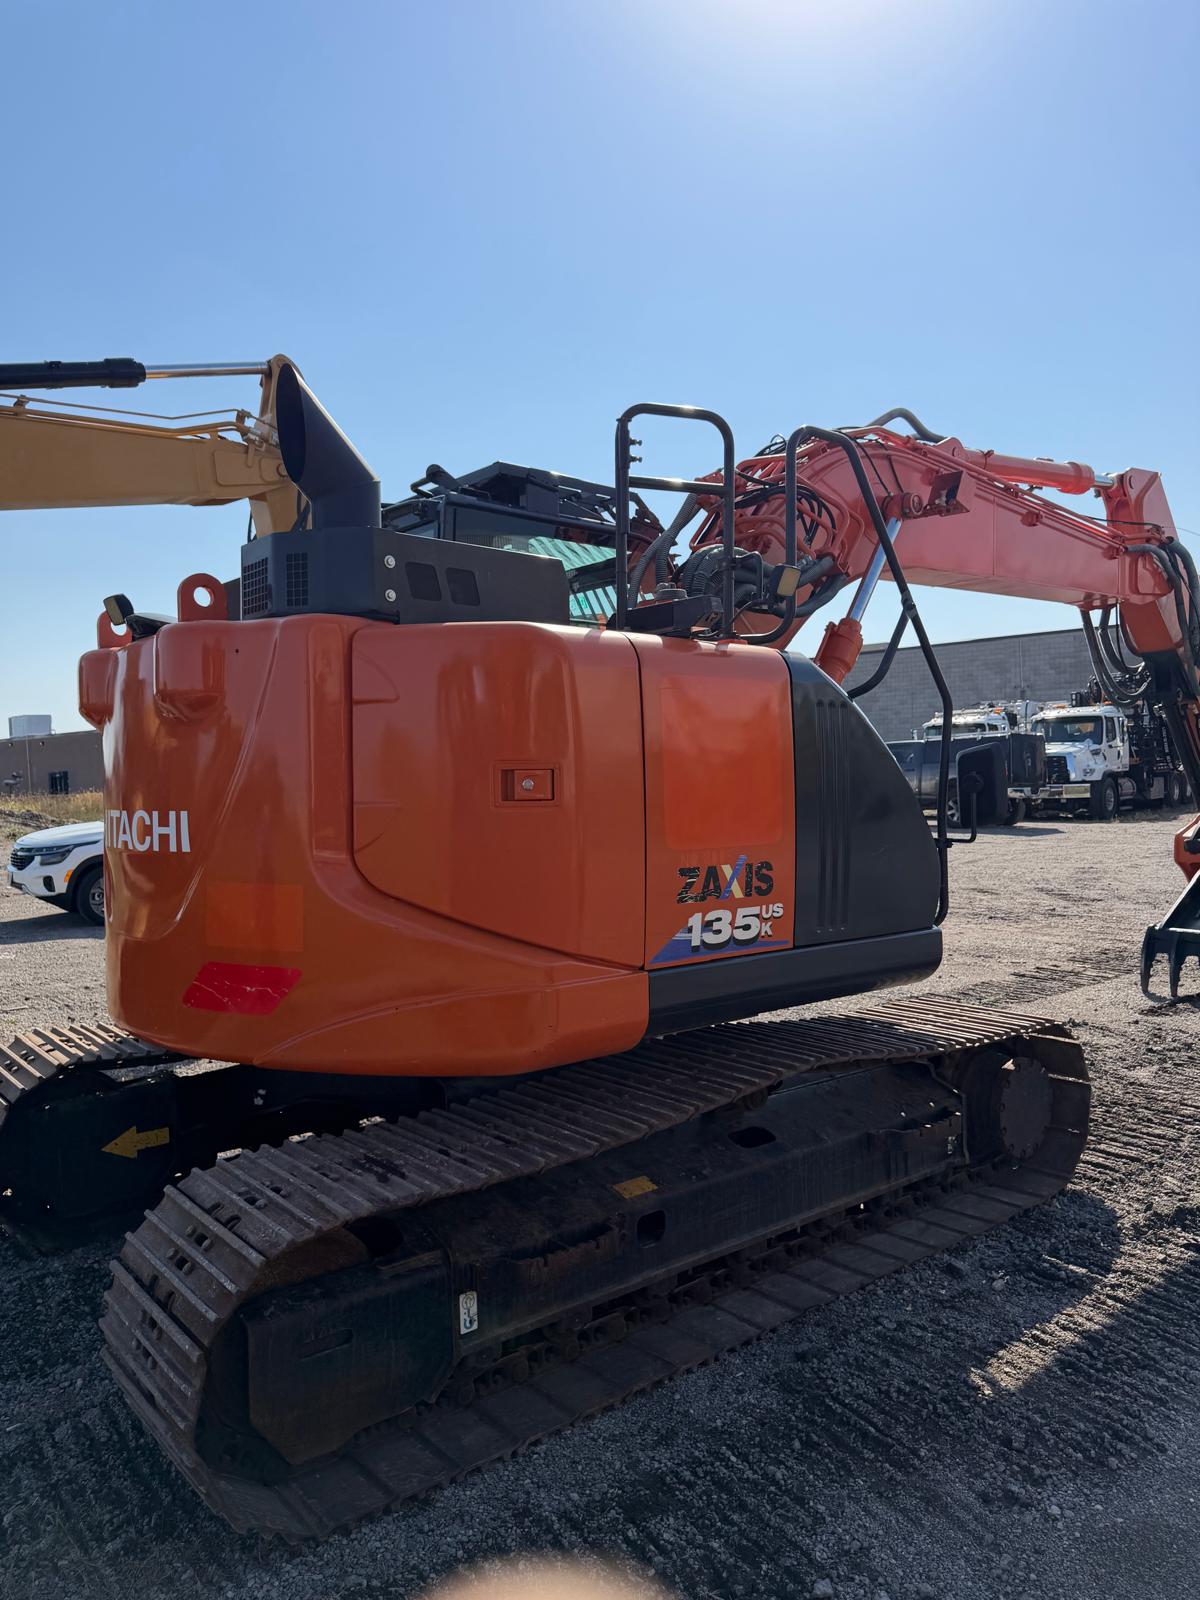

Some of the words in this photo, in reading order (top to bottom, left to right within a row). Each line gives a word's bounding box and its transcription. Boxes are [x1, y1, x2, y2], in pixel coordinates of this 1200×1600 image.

[104, 809, 190, 852] ITACHI
[676, 854, 774, 904] ZAXIS
[687, 906, 761, 953] 135
[761, 903, 784, 920] US
[761, 921, 773, 938] K
